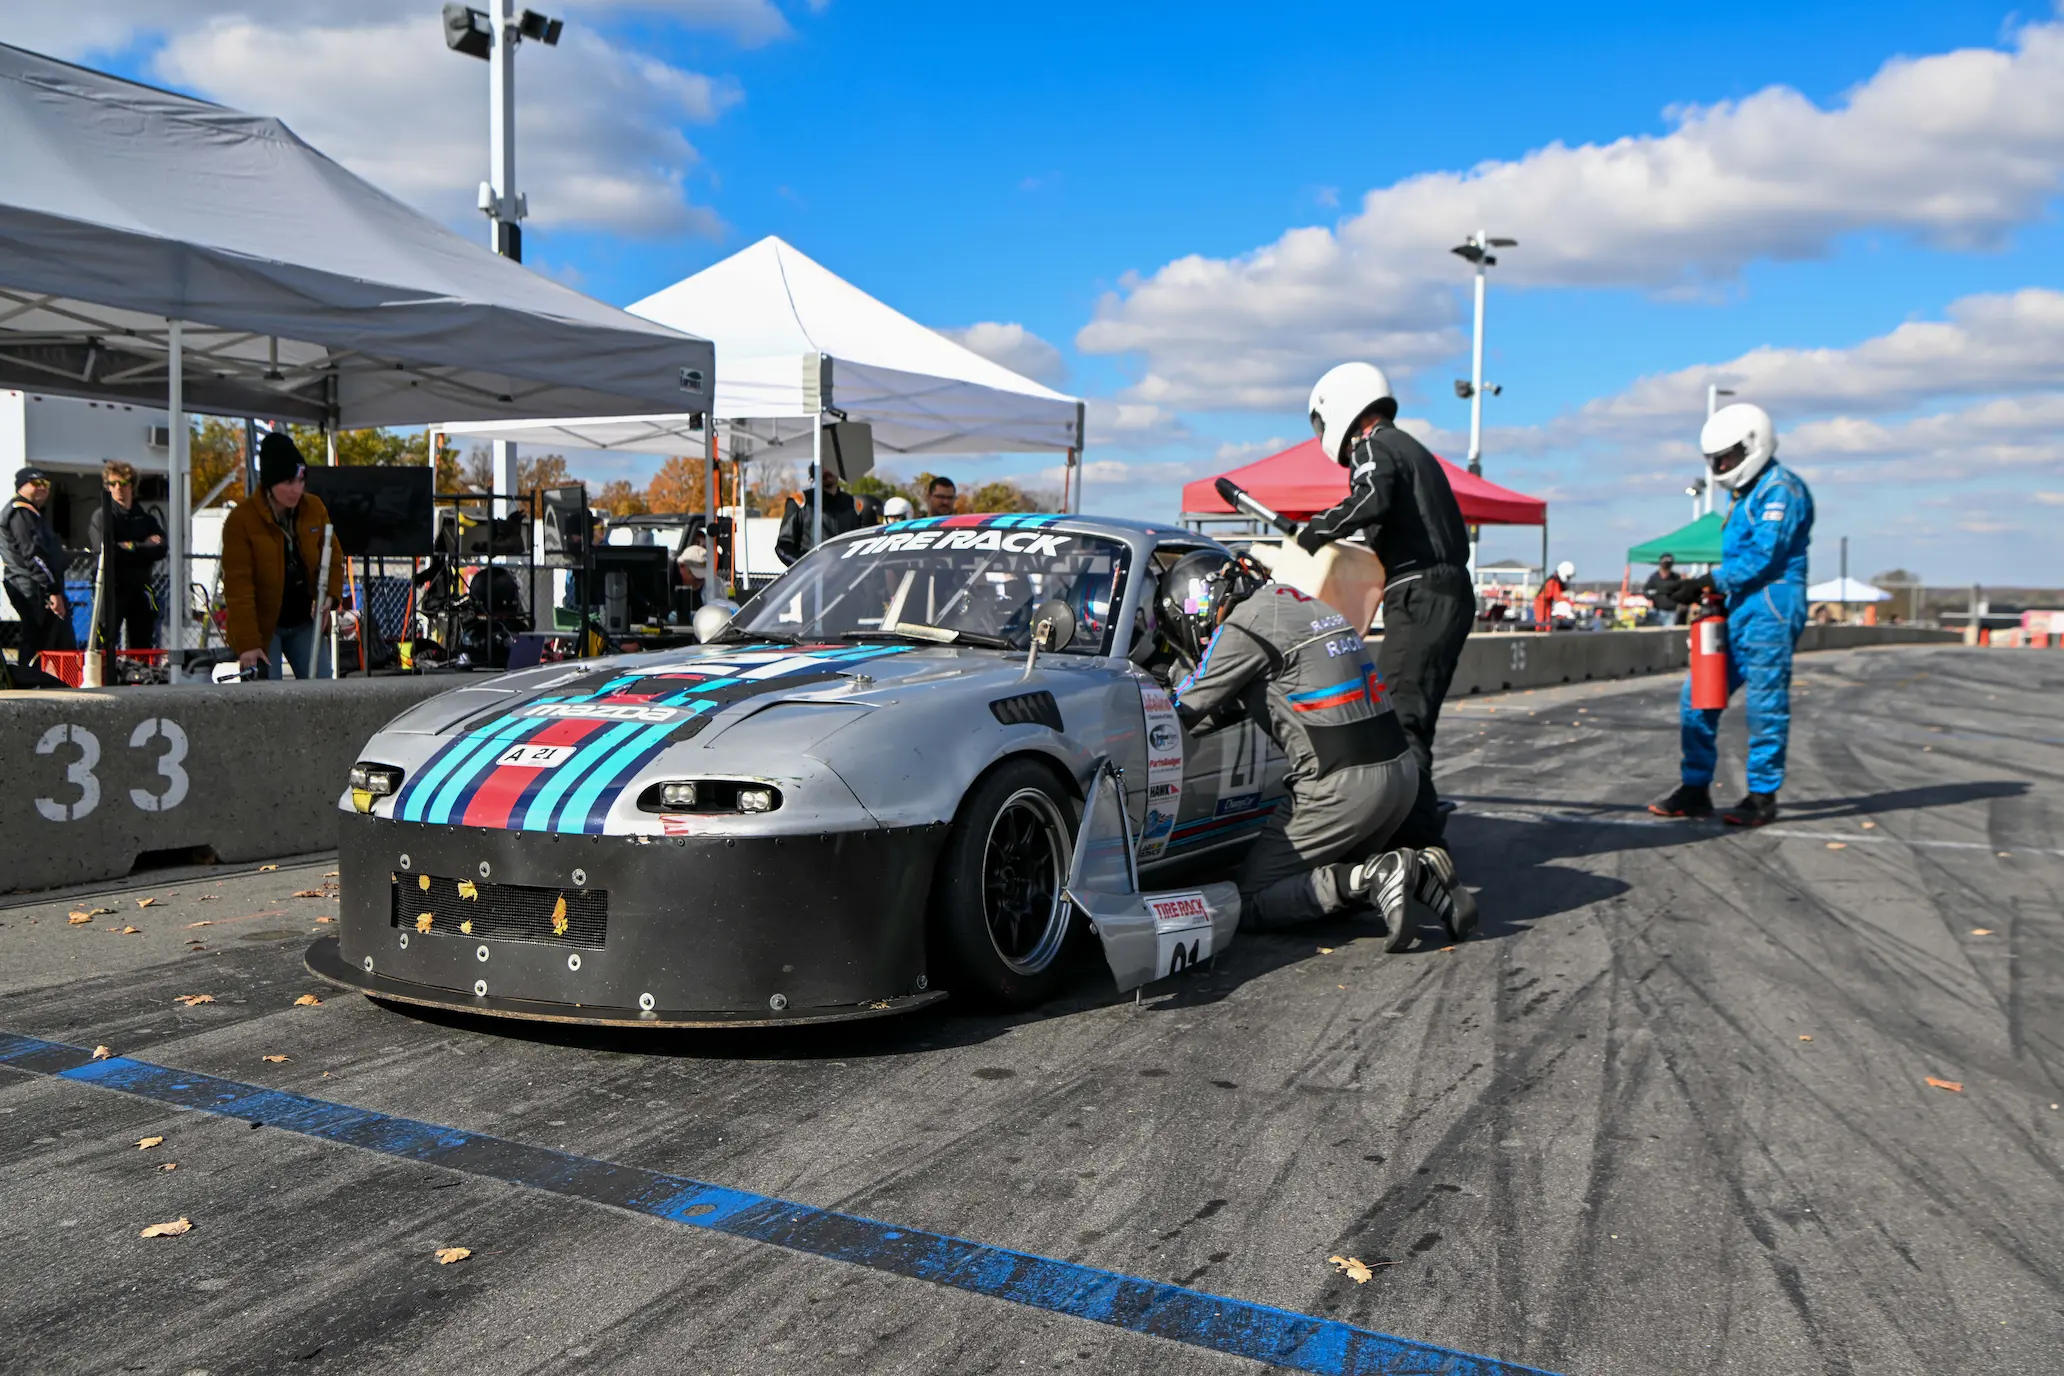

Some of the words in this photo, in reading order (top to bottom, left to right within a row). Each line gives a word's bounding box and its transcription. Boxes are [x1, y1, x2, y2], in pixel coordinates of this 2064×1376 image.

[841, 530, 944, 559] TIRE
[932, 529, 1072, 557] RACK
[504, 748, 526, 762] A
[531, 748, 558, 760] 21
[1153, 902, 1179, 919] TIRE
[1178, 899, 1209, 921] RACK
